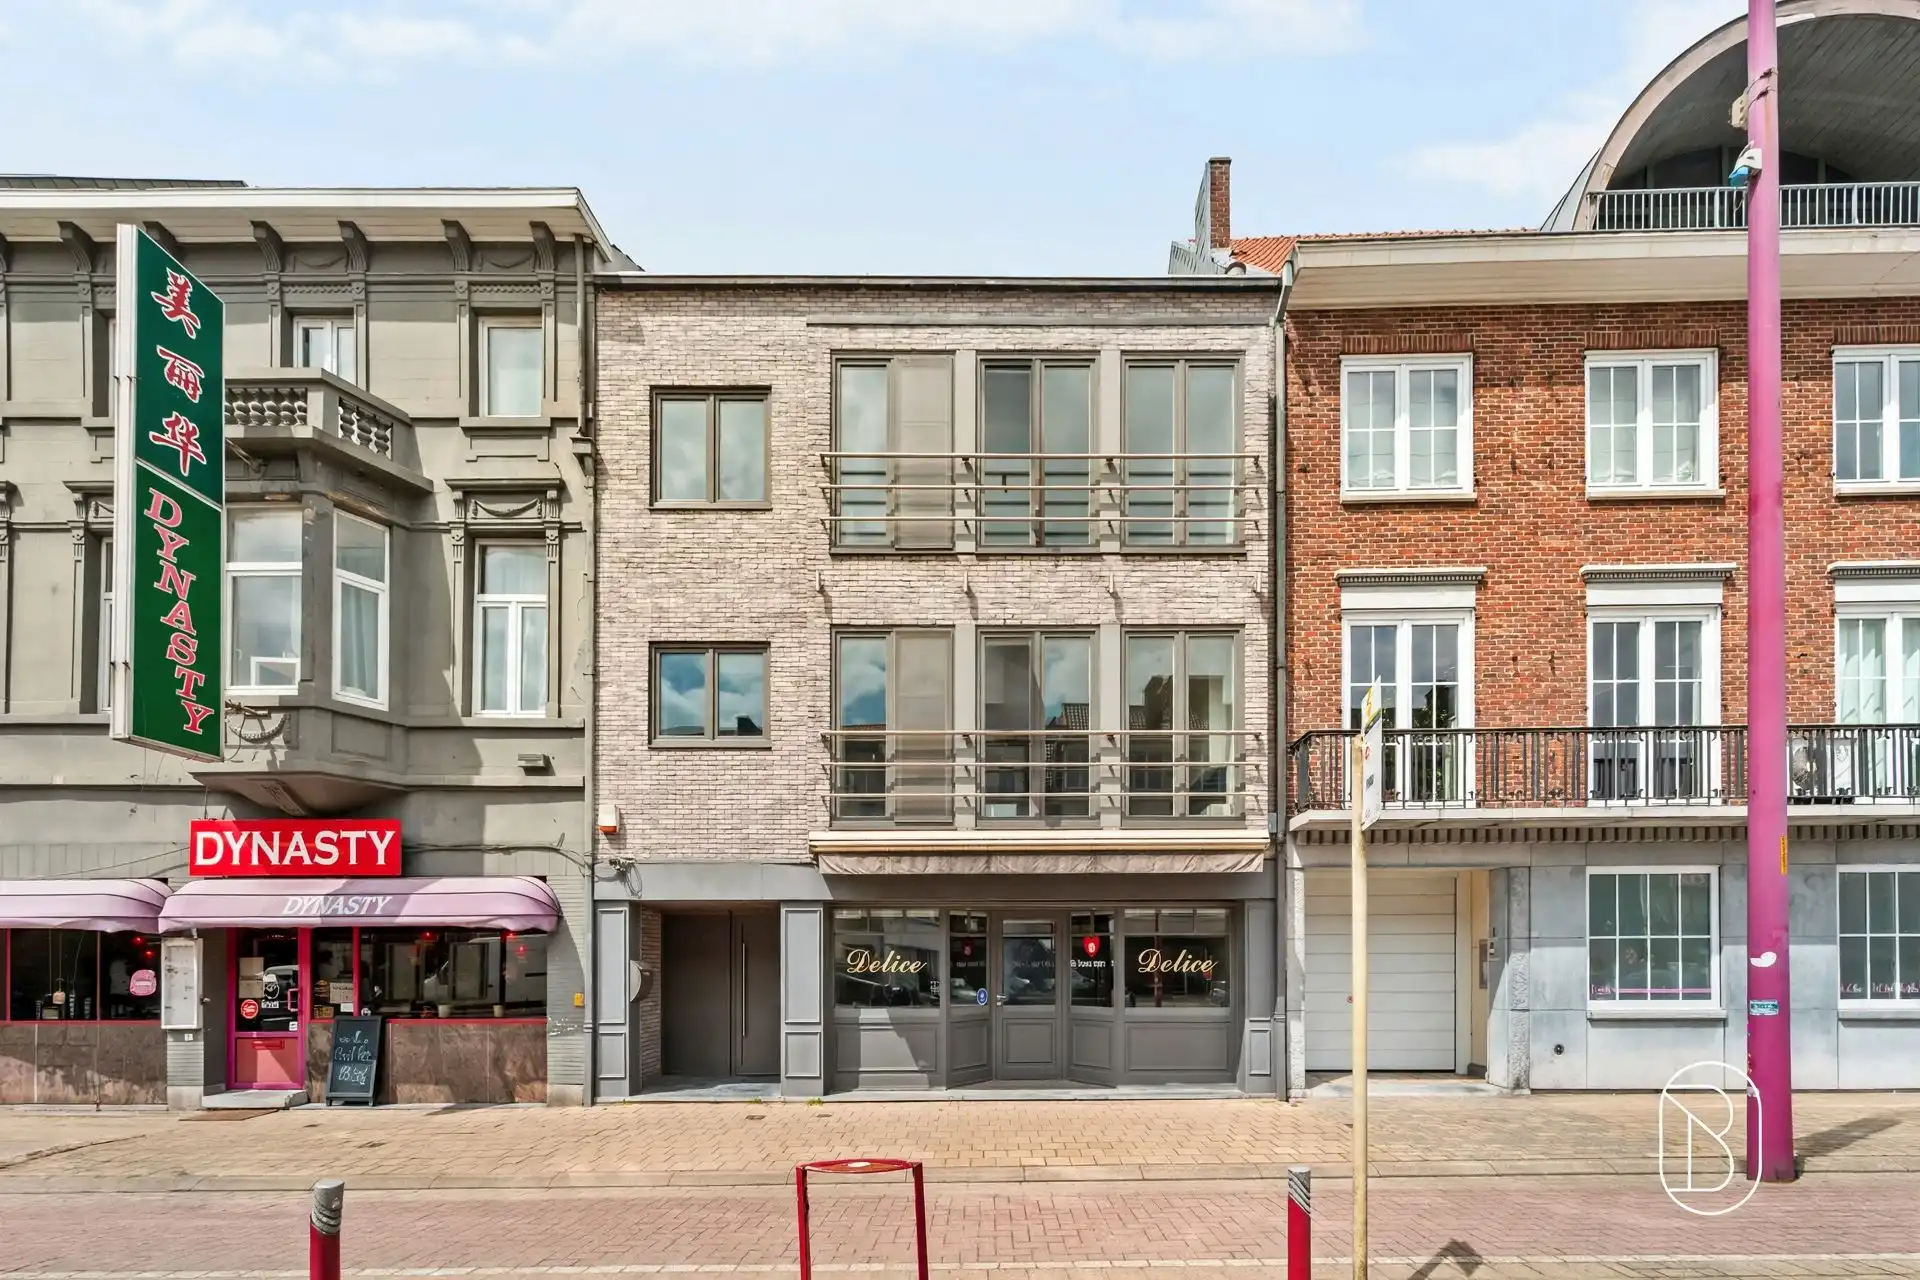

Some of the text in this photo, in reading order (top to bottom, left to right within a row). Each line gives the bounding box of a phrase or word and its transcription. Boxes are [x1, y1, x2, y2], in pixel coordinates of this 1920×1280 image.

[143, 486, 215, 736] DYNASTY
[196, 830, 395, 866] DYNASTY
[282, 895, 392, 916] DYNASTY
[846, 948, 927, 973] Delice
[1137, 948, 1218, 973] Delice
